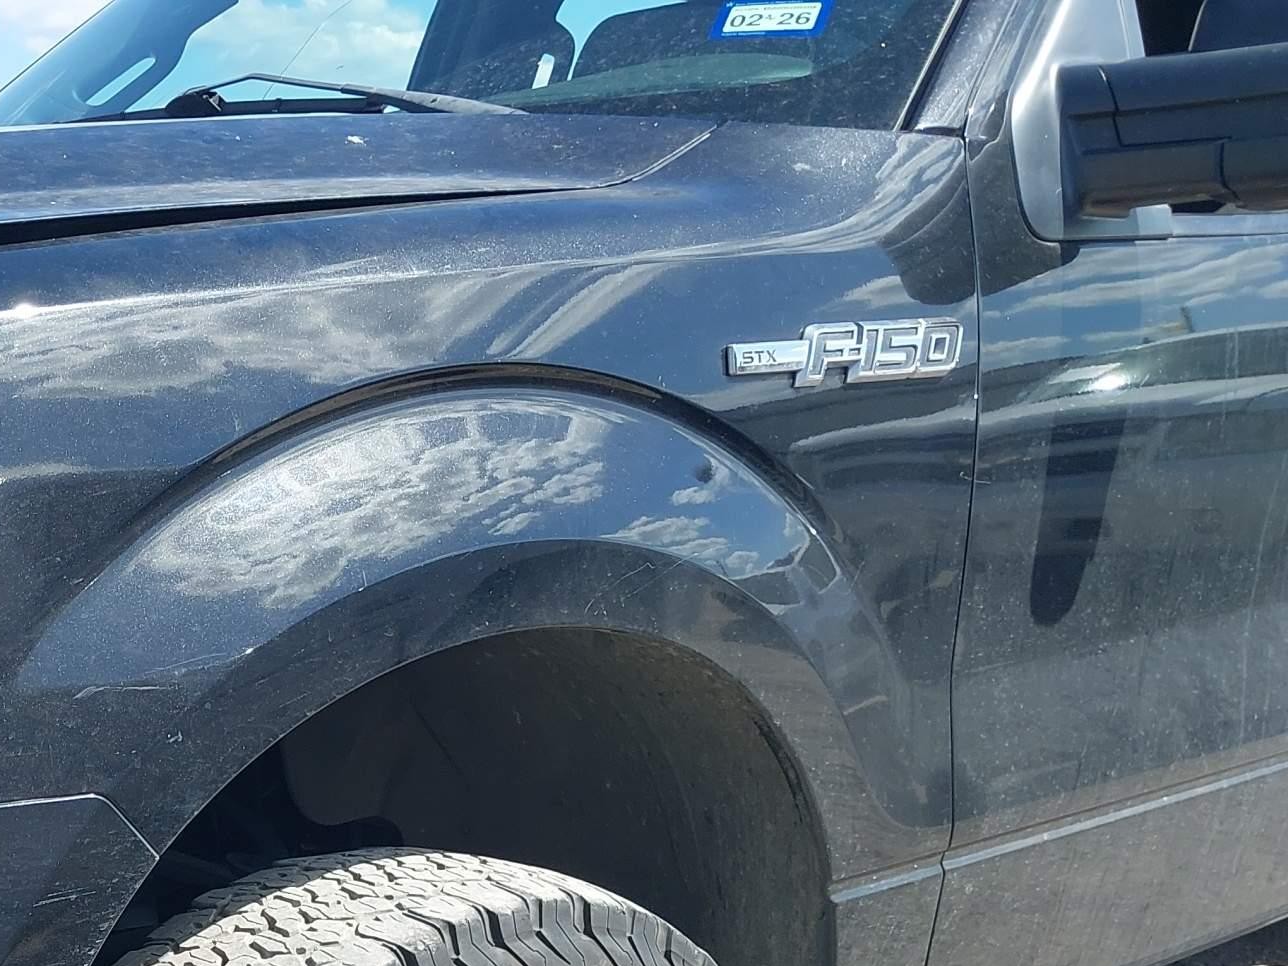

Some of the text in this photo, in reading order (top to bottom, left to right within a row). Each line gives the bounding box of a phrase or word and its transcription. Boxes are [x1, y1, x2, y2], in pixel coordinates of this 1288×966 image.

[730, 12, 812, 27] 02 26
[742, 350, 777, 365] STX
[804, 319, 963, 383] F-150
